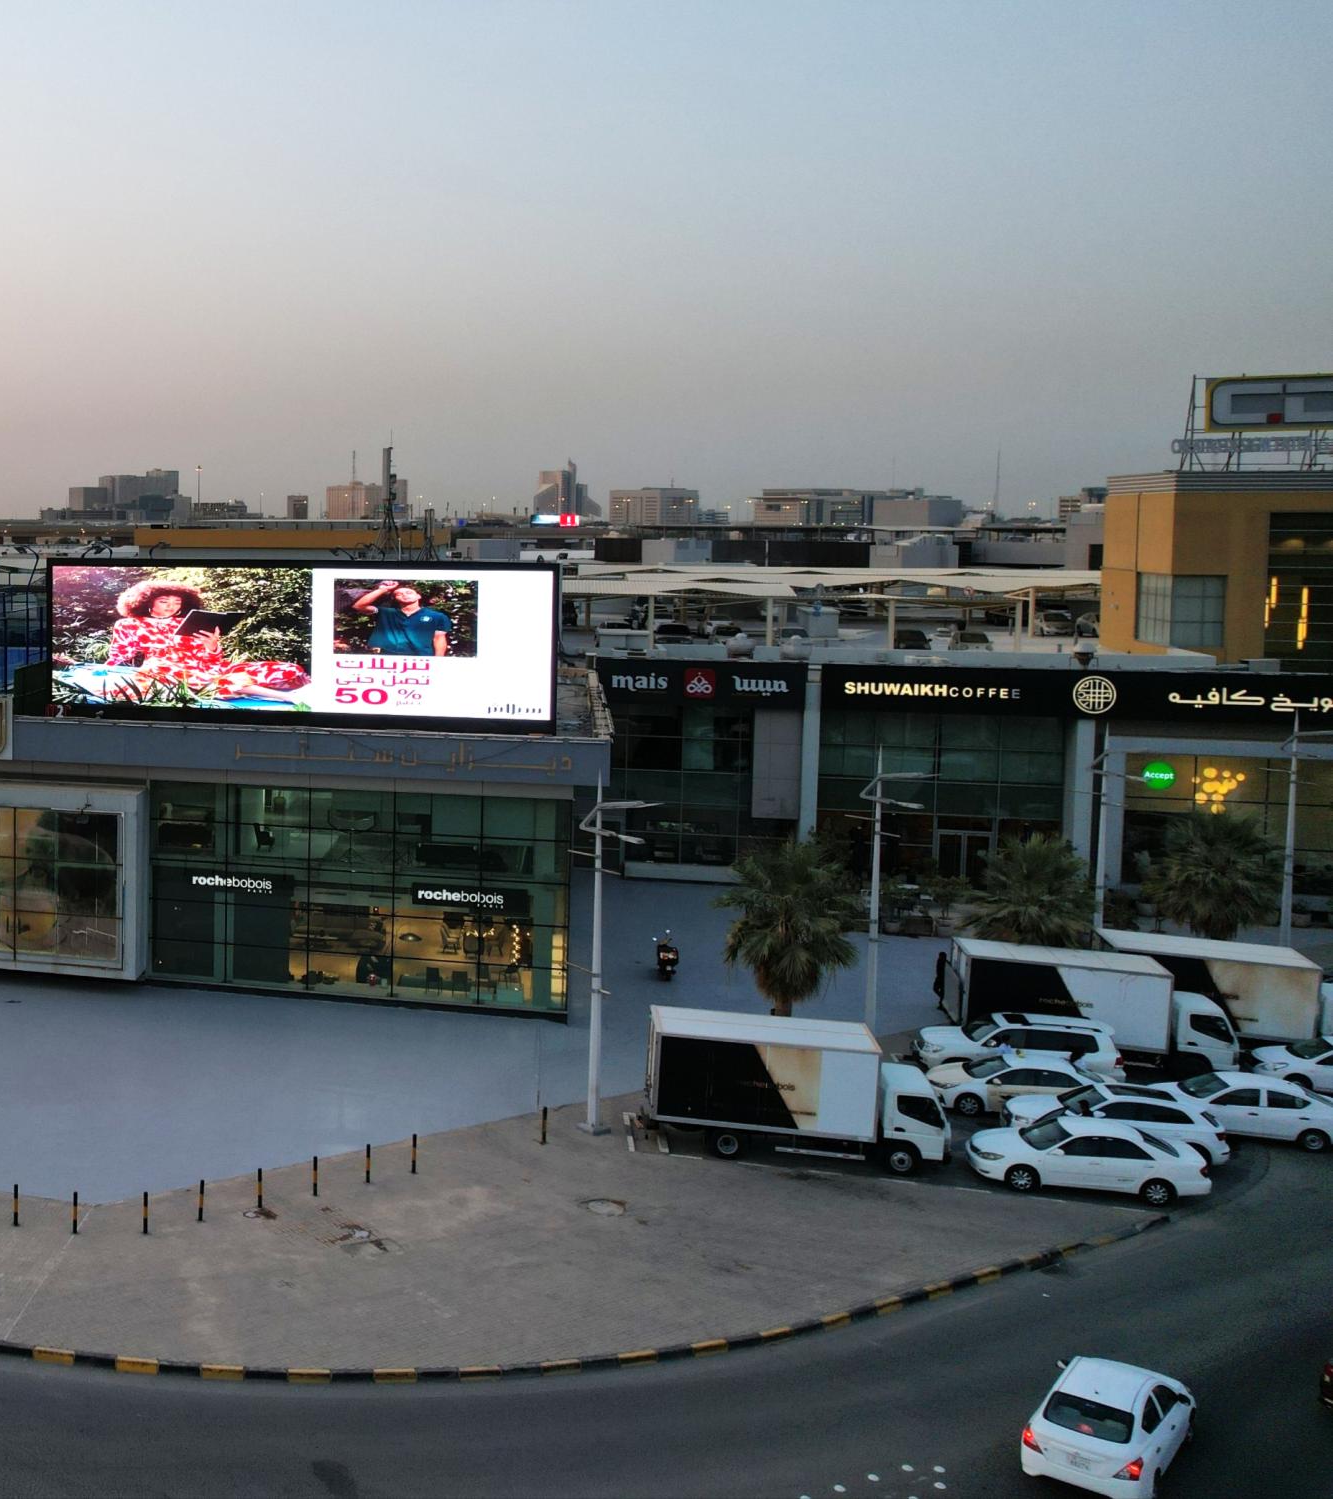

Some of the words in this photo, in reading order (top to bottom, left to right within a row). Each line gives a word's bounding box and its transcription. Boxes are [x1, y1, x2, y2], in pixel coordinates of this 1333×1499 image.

[1212, 377, 1333, 424] CD
[336, 658, 430, 673] تنزيلات
[336, 673, 374, 685] حتى
[382, 675, 430, 686] تصل
[612, 673, 668, 692] mais
[335, 687, 389, 705] 50
[398, 689, 422, 699] %
[844, 681, 948, 697] SHUWAIKH
[948, 687, 1021, 699] COFFEE
[1169, 687, 1265, 708] كافيه
[1270, 693, 1333, 713] ويخ
[1143, 771, 1175, 780] Accept
[192, 874, 273, 889] rochebobois
[417, 889, 504, 904] rochebobois
